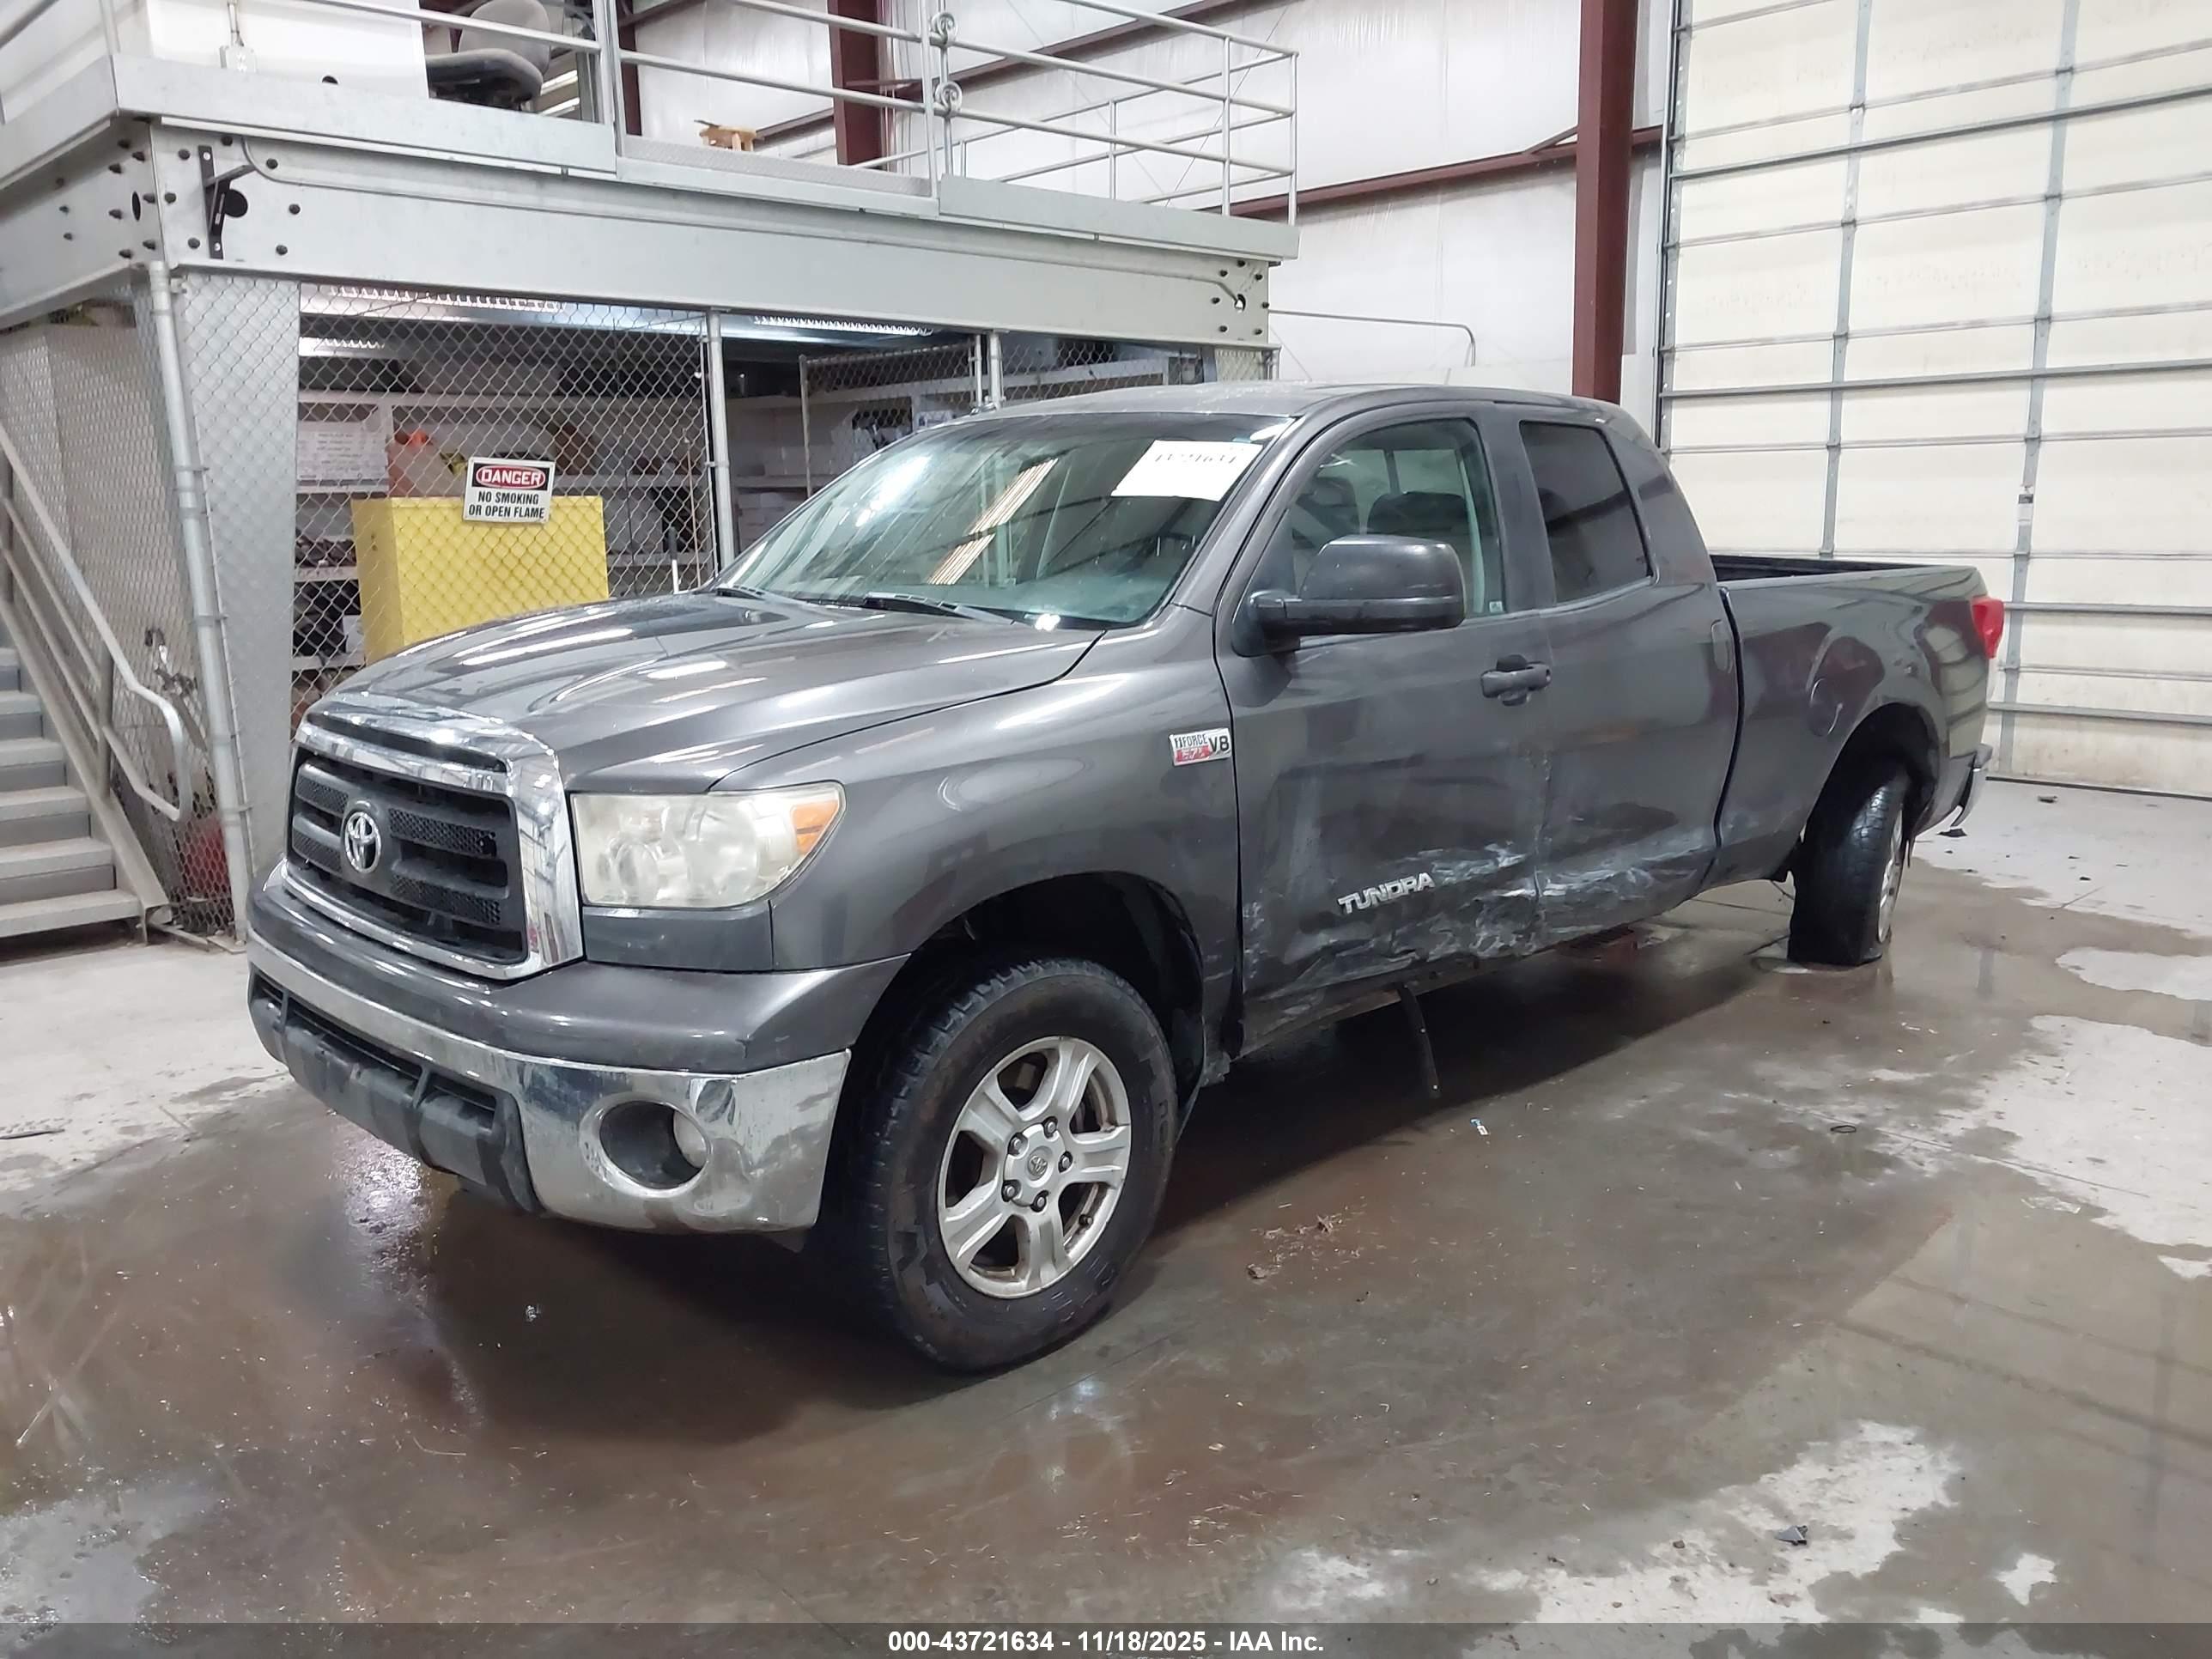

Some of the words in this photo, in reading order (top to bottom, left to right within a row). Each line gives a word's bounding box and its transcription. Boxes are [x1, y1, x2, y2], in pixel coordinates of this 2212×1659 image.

[481, 469, 541, 485] DANGER
[477, 490, 492, 503] NO
[495, 491, 539, 505] SMOKING
[468, 504, 482, 516] OR
[484, 505, 511, 518] OPEN
[514, 507, 544, 519] FLAME
[1208, 735, 1230, 752] V8
[1337, 872, 1436, 914] TUNDRA
